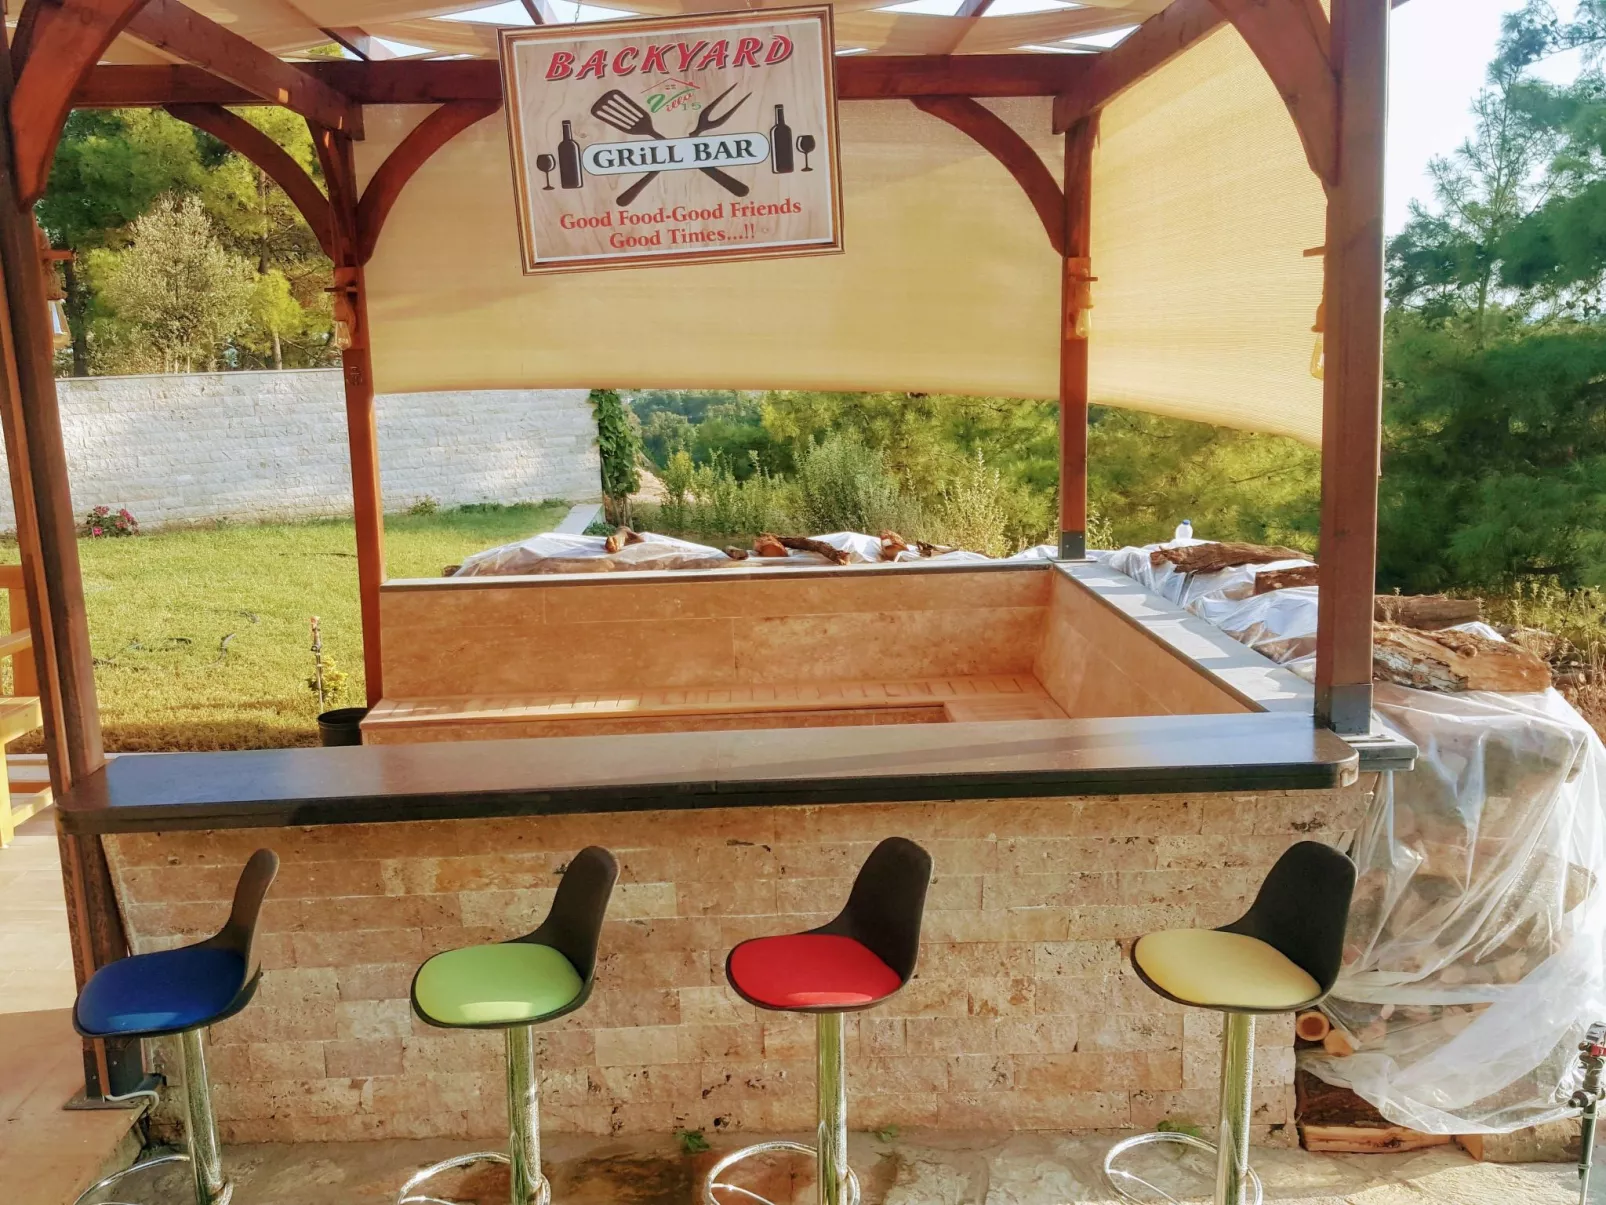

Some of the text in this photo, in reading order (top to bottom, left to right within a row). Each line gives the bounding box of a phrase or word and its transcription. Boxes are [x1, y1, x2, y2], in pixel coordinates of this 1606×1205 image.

[545, 35, 794, 81] BACKYARD
[693, 138, 757, 163] BAR
[559, 197, 802, 231] Good Food-Good Friends
[609, 224, 756, 249] Good Times...!!
